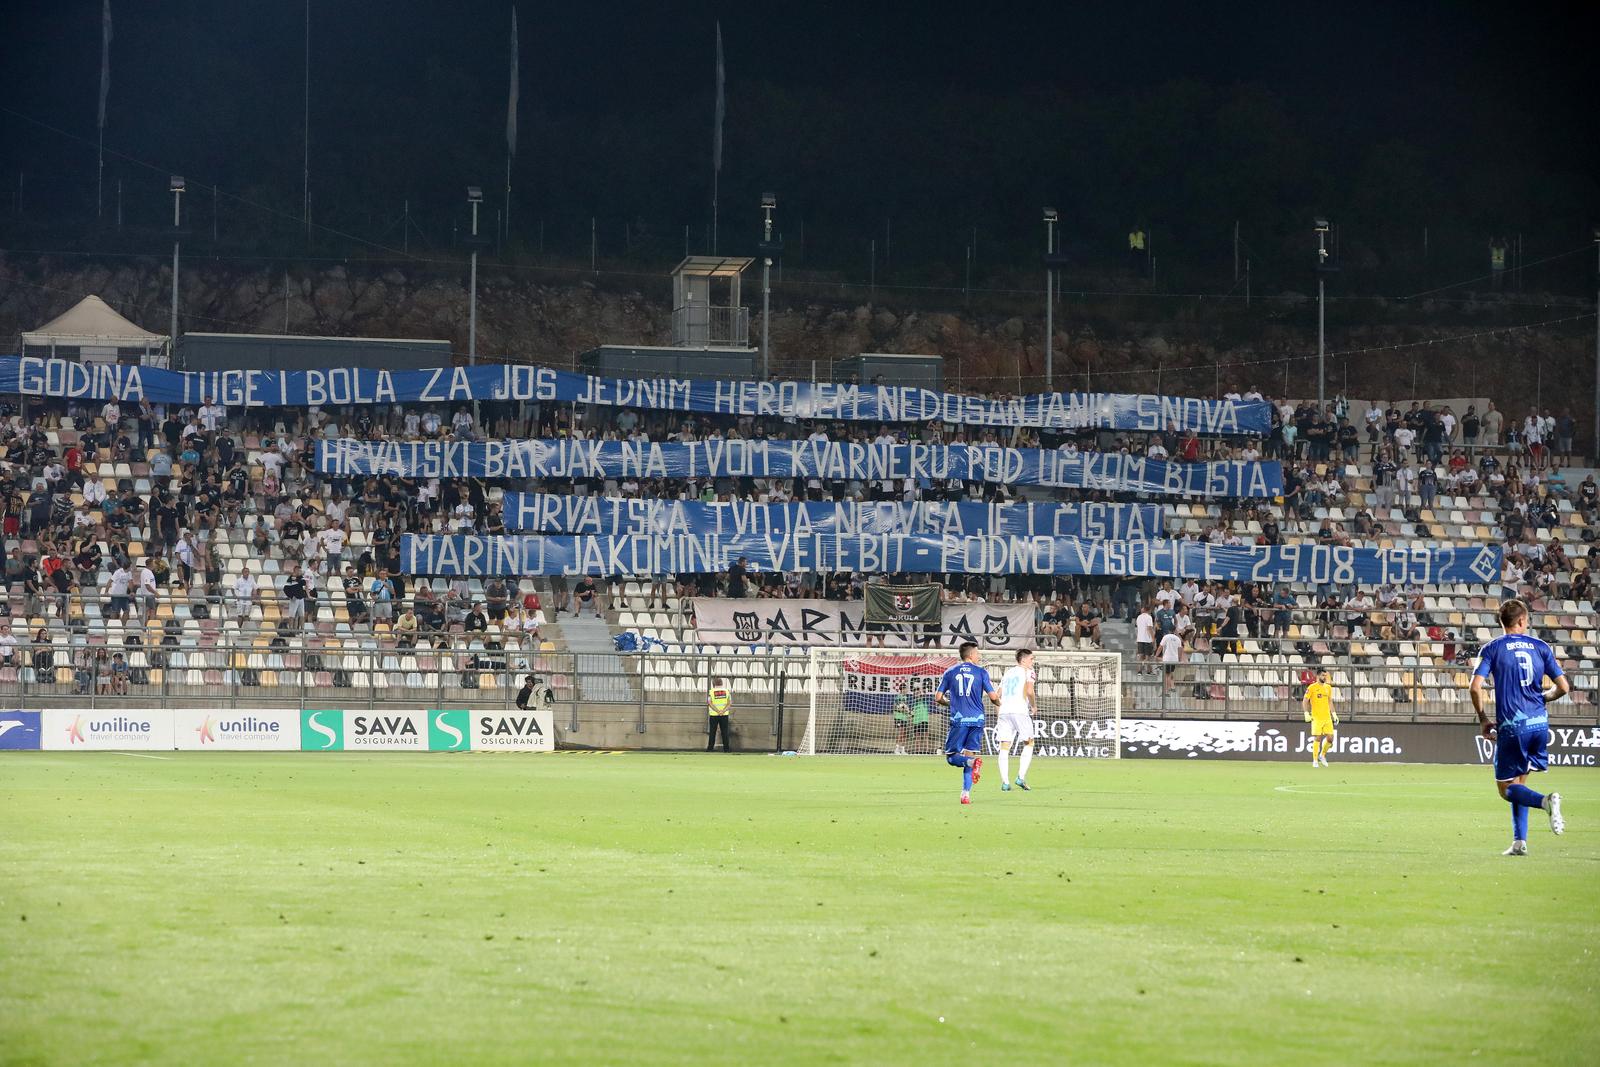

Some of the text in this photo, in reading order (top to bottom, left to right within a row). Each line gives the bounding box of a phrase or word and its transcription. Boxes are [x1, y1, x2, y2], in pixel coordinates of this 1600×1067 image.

[19, 357, 144, 400] GODINA
[177, 369, 264, 406] TUGE
[280, 371, 287, 405] I
[306, 368, 396, 405] BOLA
[418, 367, 473, 401] ZA
[322, 439, 470, 477] HRVATSKI
[485, 439, 606, 477] BARJAK
[622, 441, 667, 477] NA
[682, 440, 769, 477] TVOM
[791, 440, 948, 479] KVARNERU
[967, 446, 1024, 484] POD
[1038, 449, 1145, 492] UČKOM
[518, 491, 689, 536] HRVATSKA
[1028, 503, 1034, 536] I
[410, 535, 544, 575] MARINO
[764, 533, 903, 573] VELEBIT
[940, 533, 1054, 574] PODNO
[1515, 651, 1534, 687] 3
[955, 674, 975, 697] 17
[90, 717, 150, 732] uniline
[219, 717, 280, 732] uniline
[354, 717, 418, 735] SAVA
[481, 717, 544, 735] SAVA
[113, 734, 150, 742] company
[243, 734, 280, 742] company
[1039, 746, 1110, 757] ADRIATIC
